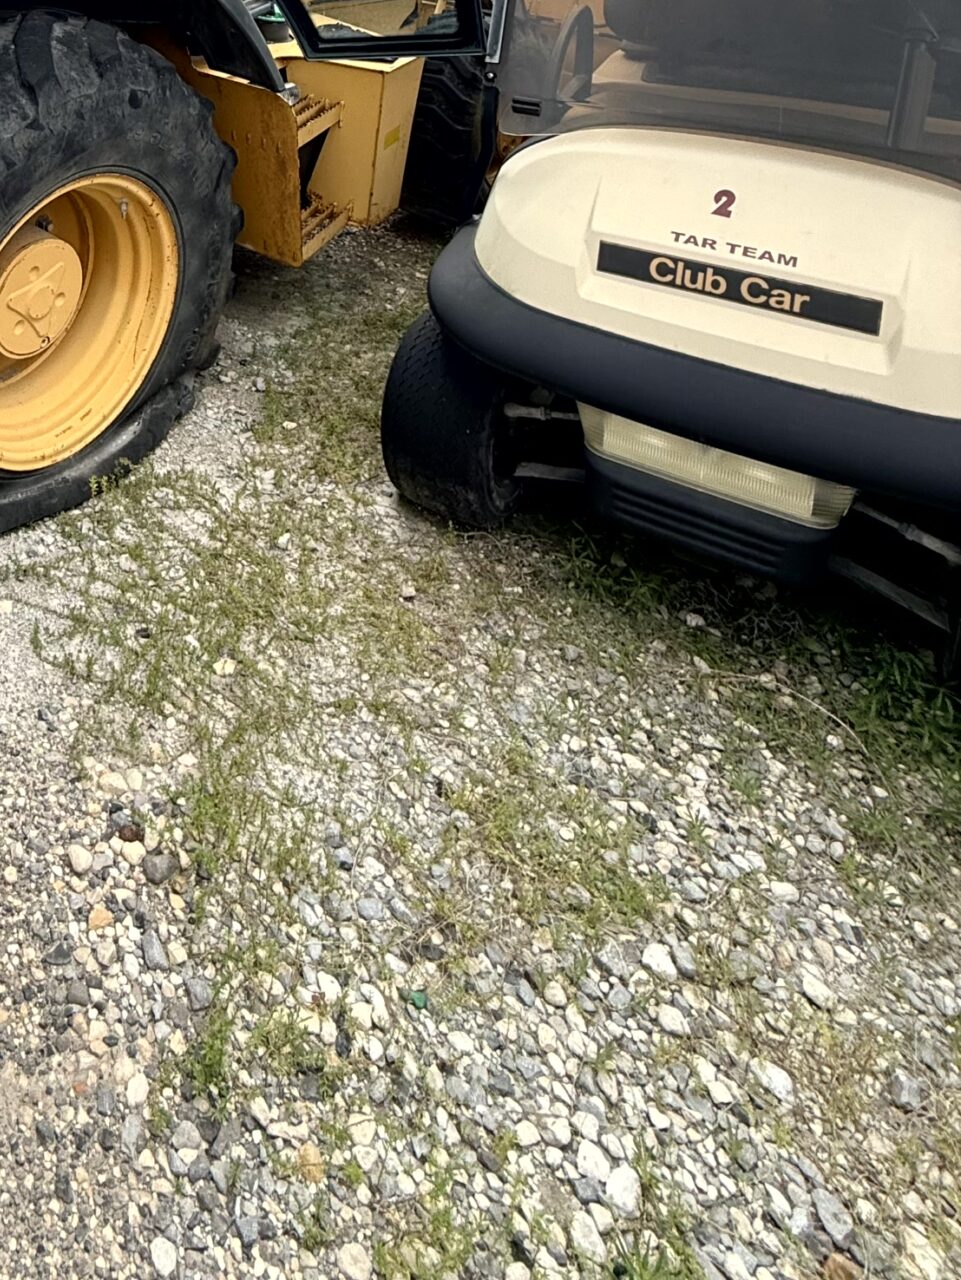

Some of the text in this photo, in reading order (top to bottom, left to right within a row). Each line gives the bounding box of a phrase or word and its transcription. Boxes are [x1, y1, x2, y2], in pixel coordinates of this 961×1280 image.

[711, 189, 736, 218] 2
[671, 230, 798, 268] TAR TEAM
[649, 257, 810, 313] Club Car
